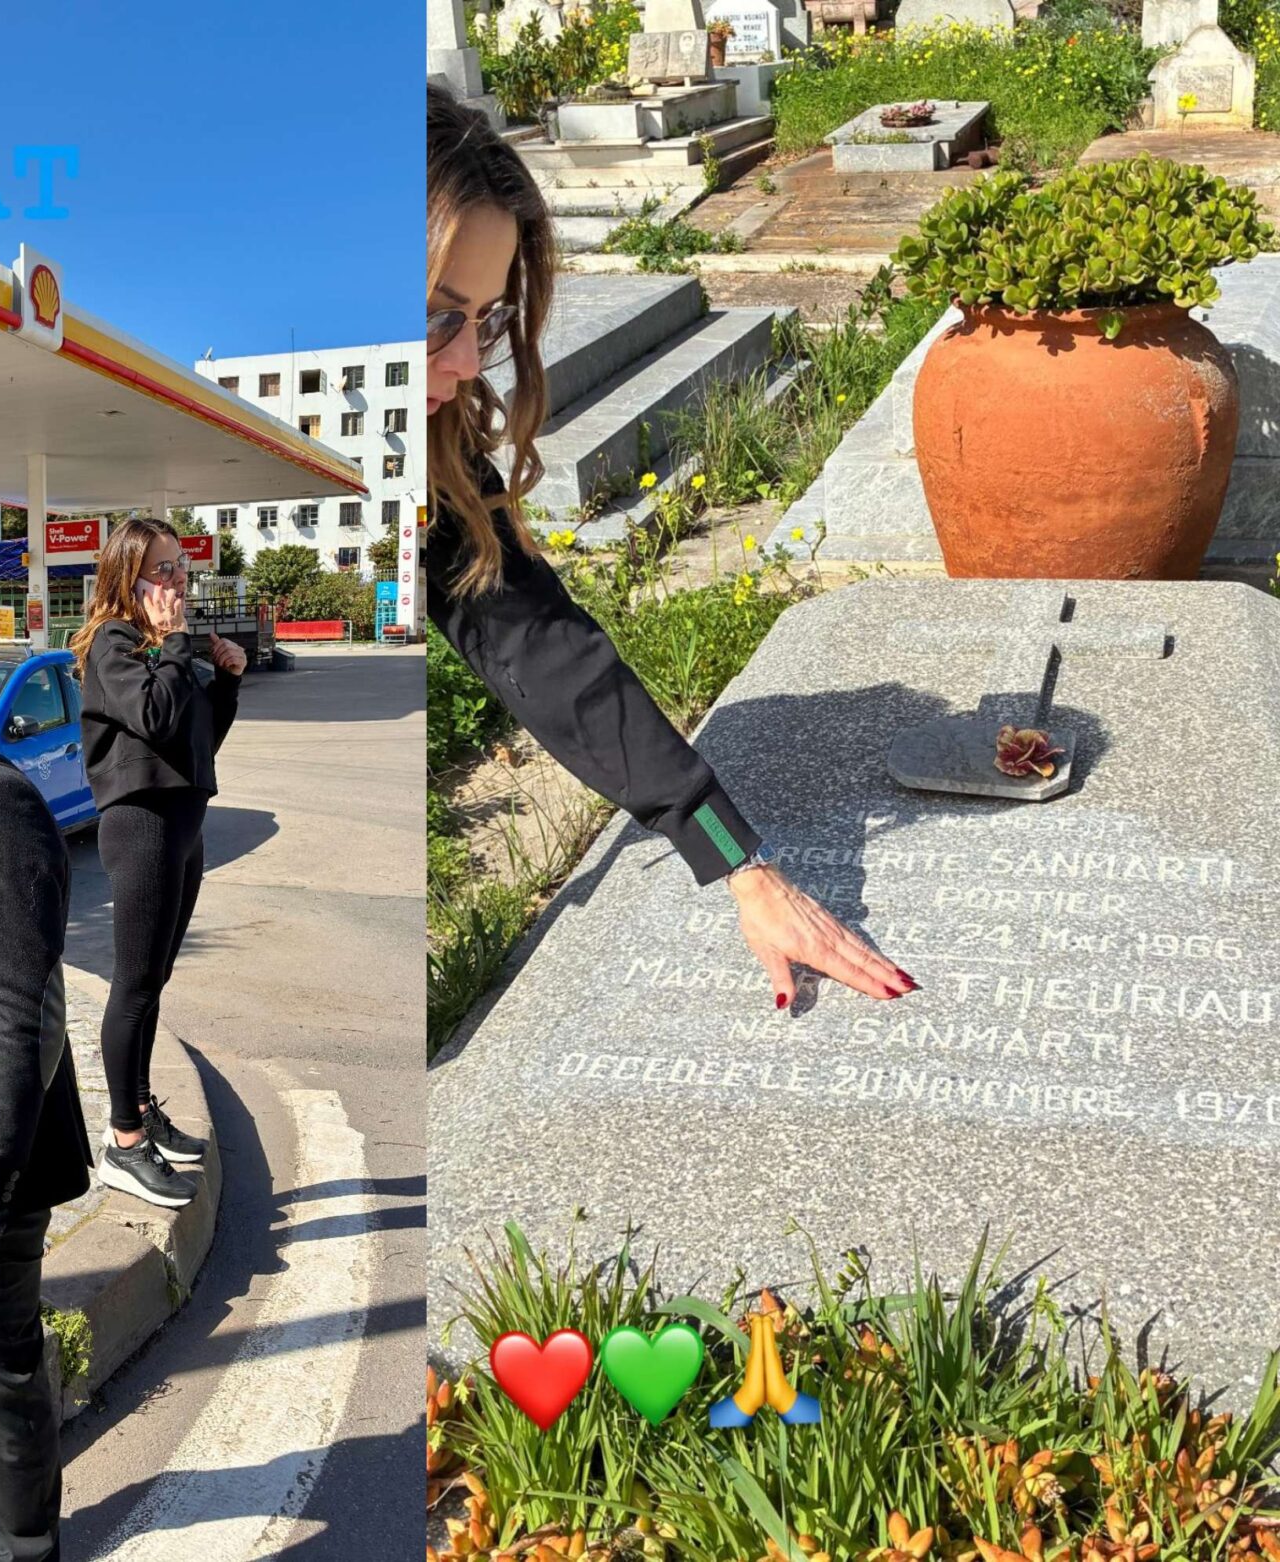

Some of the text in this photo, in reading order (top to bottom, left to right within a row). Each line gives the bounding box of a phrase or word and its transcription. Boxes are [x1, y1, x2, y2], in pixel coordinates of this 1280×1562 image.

[48, 526, 64, 535] Shell
[49, 534, 89, 544] V-Power
[181, 546, 204, 554] ower
[776, 846, 1233, 888] RGUERITE SANMARTI
[933, 885, 1126, 915] PORTIER
[885, 922, 927, 943] LE
[956, 924, 1015, 949] 24
[1137, 930, 1244, 961] 1966
[849, 1017, 1134, 1066] SANMARTI
[758, 1061, 810, 1092] LE
[830, 1065, 886, 1098] 20
[894, 1067, 1135, 1117] NOVEMBRE
